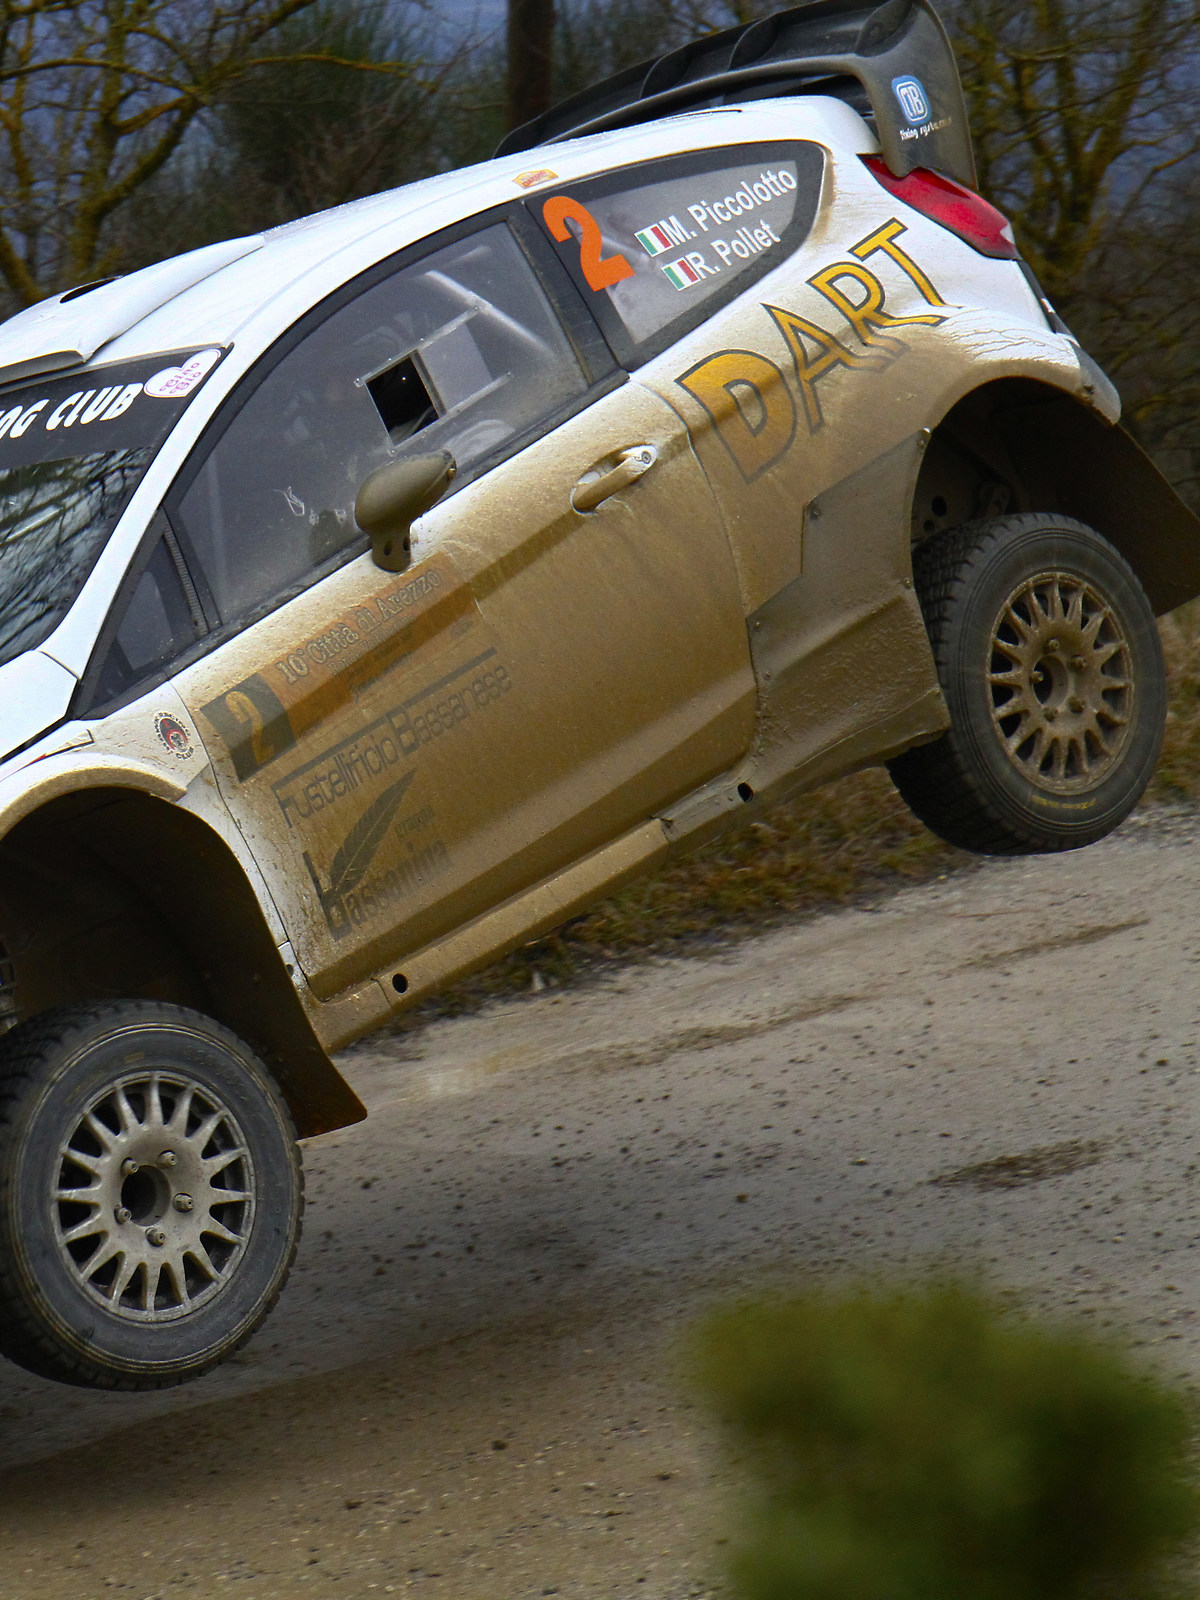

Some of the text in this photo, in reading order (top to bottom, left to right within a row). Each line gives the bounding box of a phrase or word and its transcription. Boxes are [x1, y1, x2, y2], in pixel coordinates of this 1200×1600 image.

[542, 196, 635, 292] 2
[659, 170, 797, 245] M. Piccolotto
[685, 219, 781, 279] R. Pollet
[674, 218, 963, 485] DART
[45, 382, 144, 430] CLUB
[374, 569, 441, 622] Arezzo
[222, 688, 280, 764] 2
